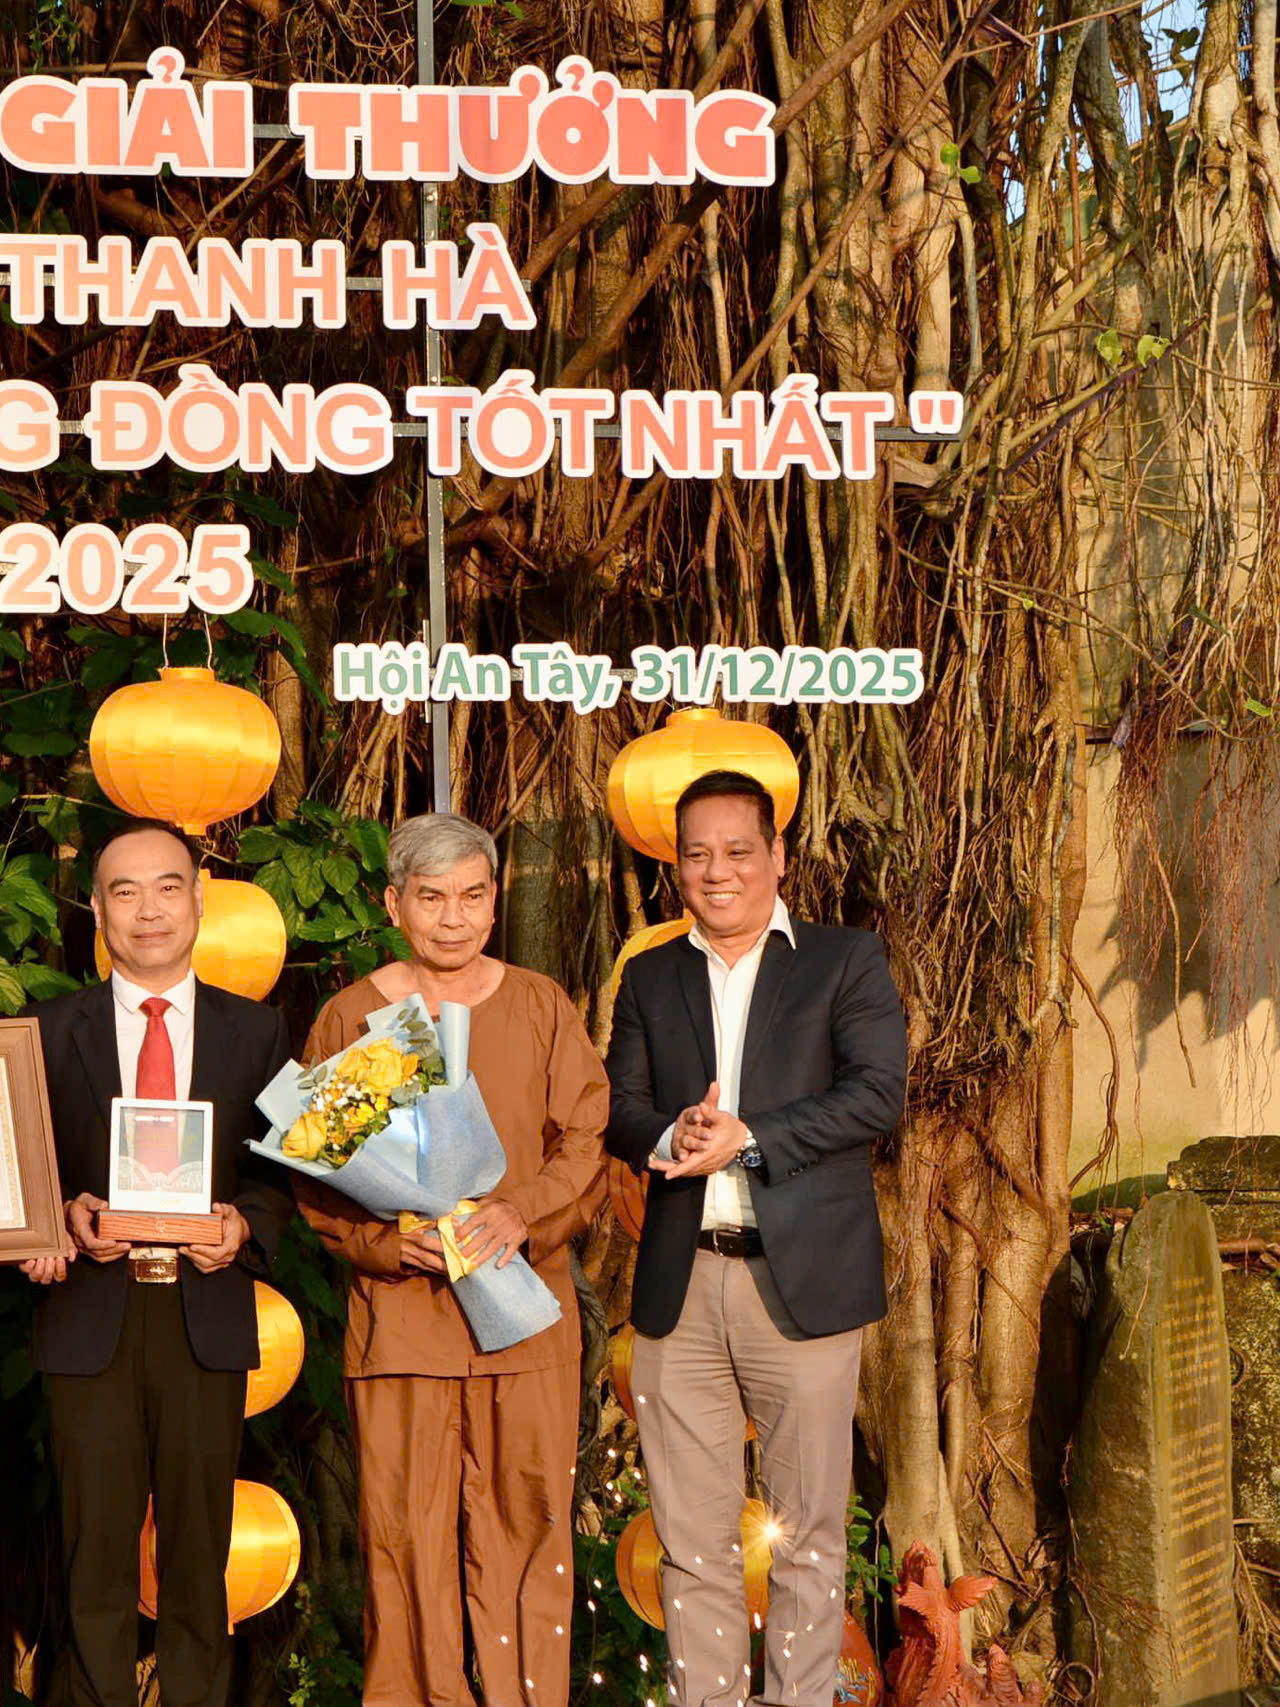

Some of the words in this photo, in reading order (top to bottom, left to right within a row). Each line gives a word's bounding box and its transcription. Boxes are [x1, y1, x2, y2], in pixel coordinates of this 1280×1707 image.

[290, 55, 775, 186] THƯỞNG
[383, 222, 537, 330] HÀ
[84, 364, 394, 475] ĐỒNG
[406, 369, 615, 479] TỐT
[334, 640, 428, 715] Hội
[431, 643, 510, 703] An
[512, 641, 621, 715] Tây,
[632, 644, 924, 706] 31/12/2025
